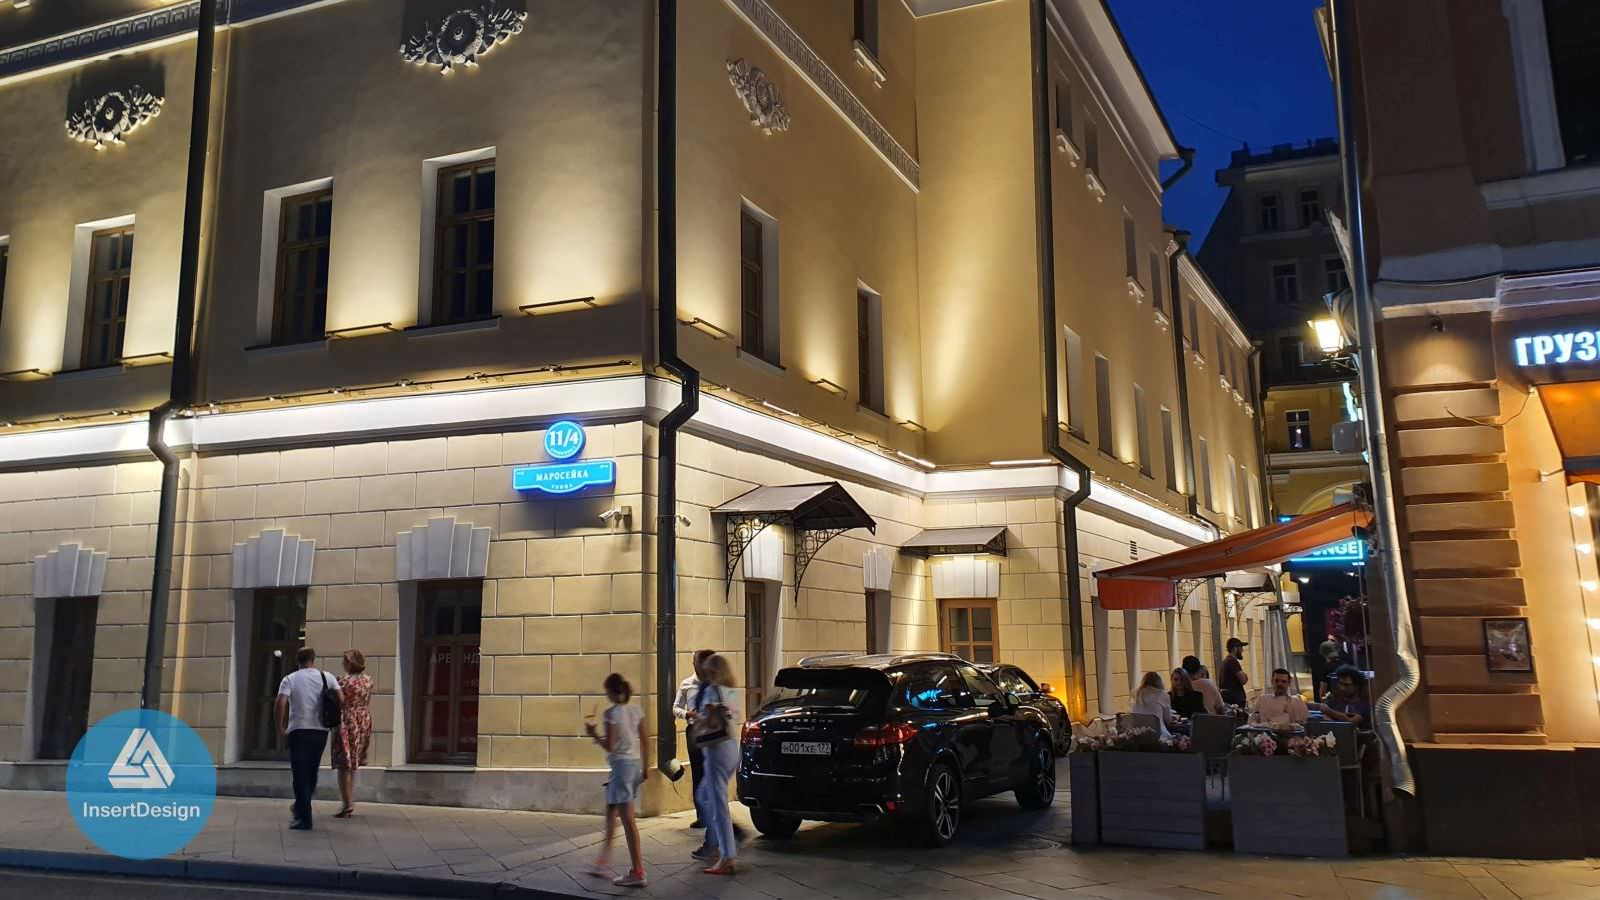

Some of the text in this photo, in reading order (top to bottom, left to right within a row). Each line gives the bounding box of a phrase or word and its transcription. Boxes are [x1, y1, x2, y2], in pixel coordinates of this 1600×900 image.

[1515, 331, 1600, 366] ГРУЗ
[549, 428, 579, 448] 11/4
[536, 470, 589, 482] МАРОСЕЙКА
